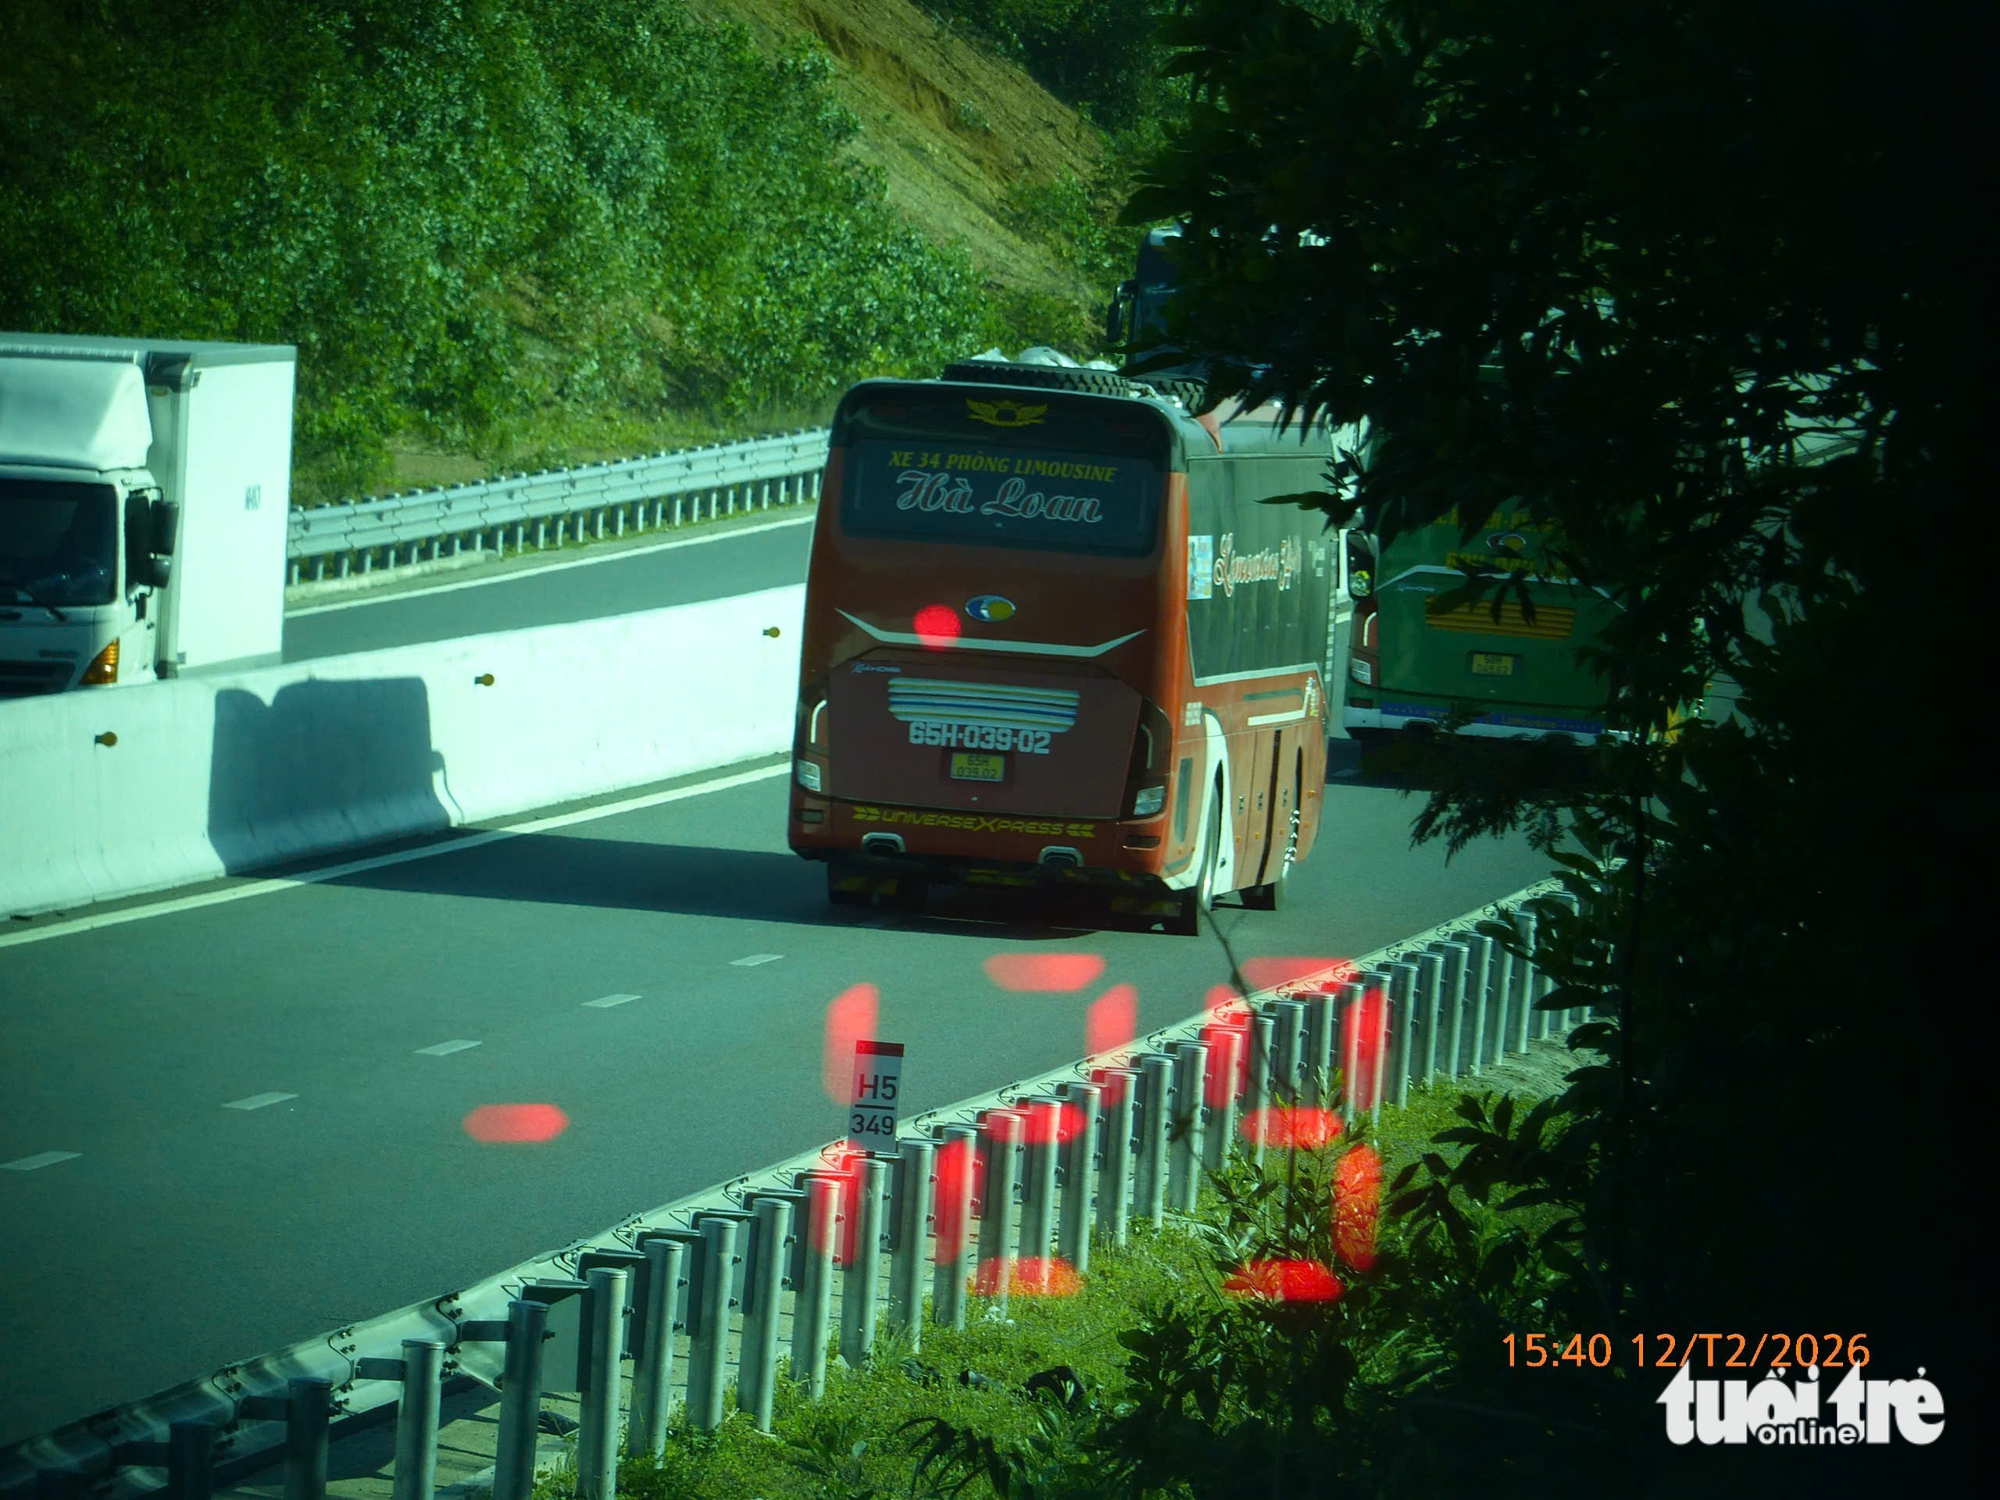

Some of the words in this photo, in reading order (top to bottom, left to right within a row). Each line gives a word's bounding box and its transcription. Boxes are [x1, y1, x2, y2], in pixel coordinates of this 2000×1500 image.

[888, 450, 912, 467] XE
[918, 454, 941, 469] 34
[946, 450, 1010, 474] PHÒNG
[1014, 456, 1118, 483] LIMOUSINE
[896, 470, 975, 514] Hà
[980, 477, 1103, 524] Loan
[956, 766, 998, 780] 039.02
[966, 755, 990, 767] 65H
[858, 1073, 897, 1101] H5
[851, 1113, 894, 1136] 349
